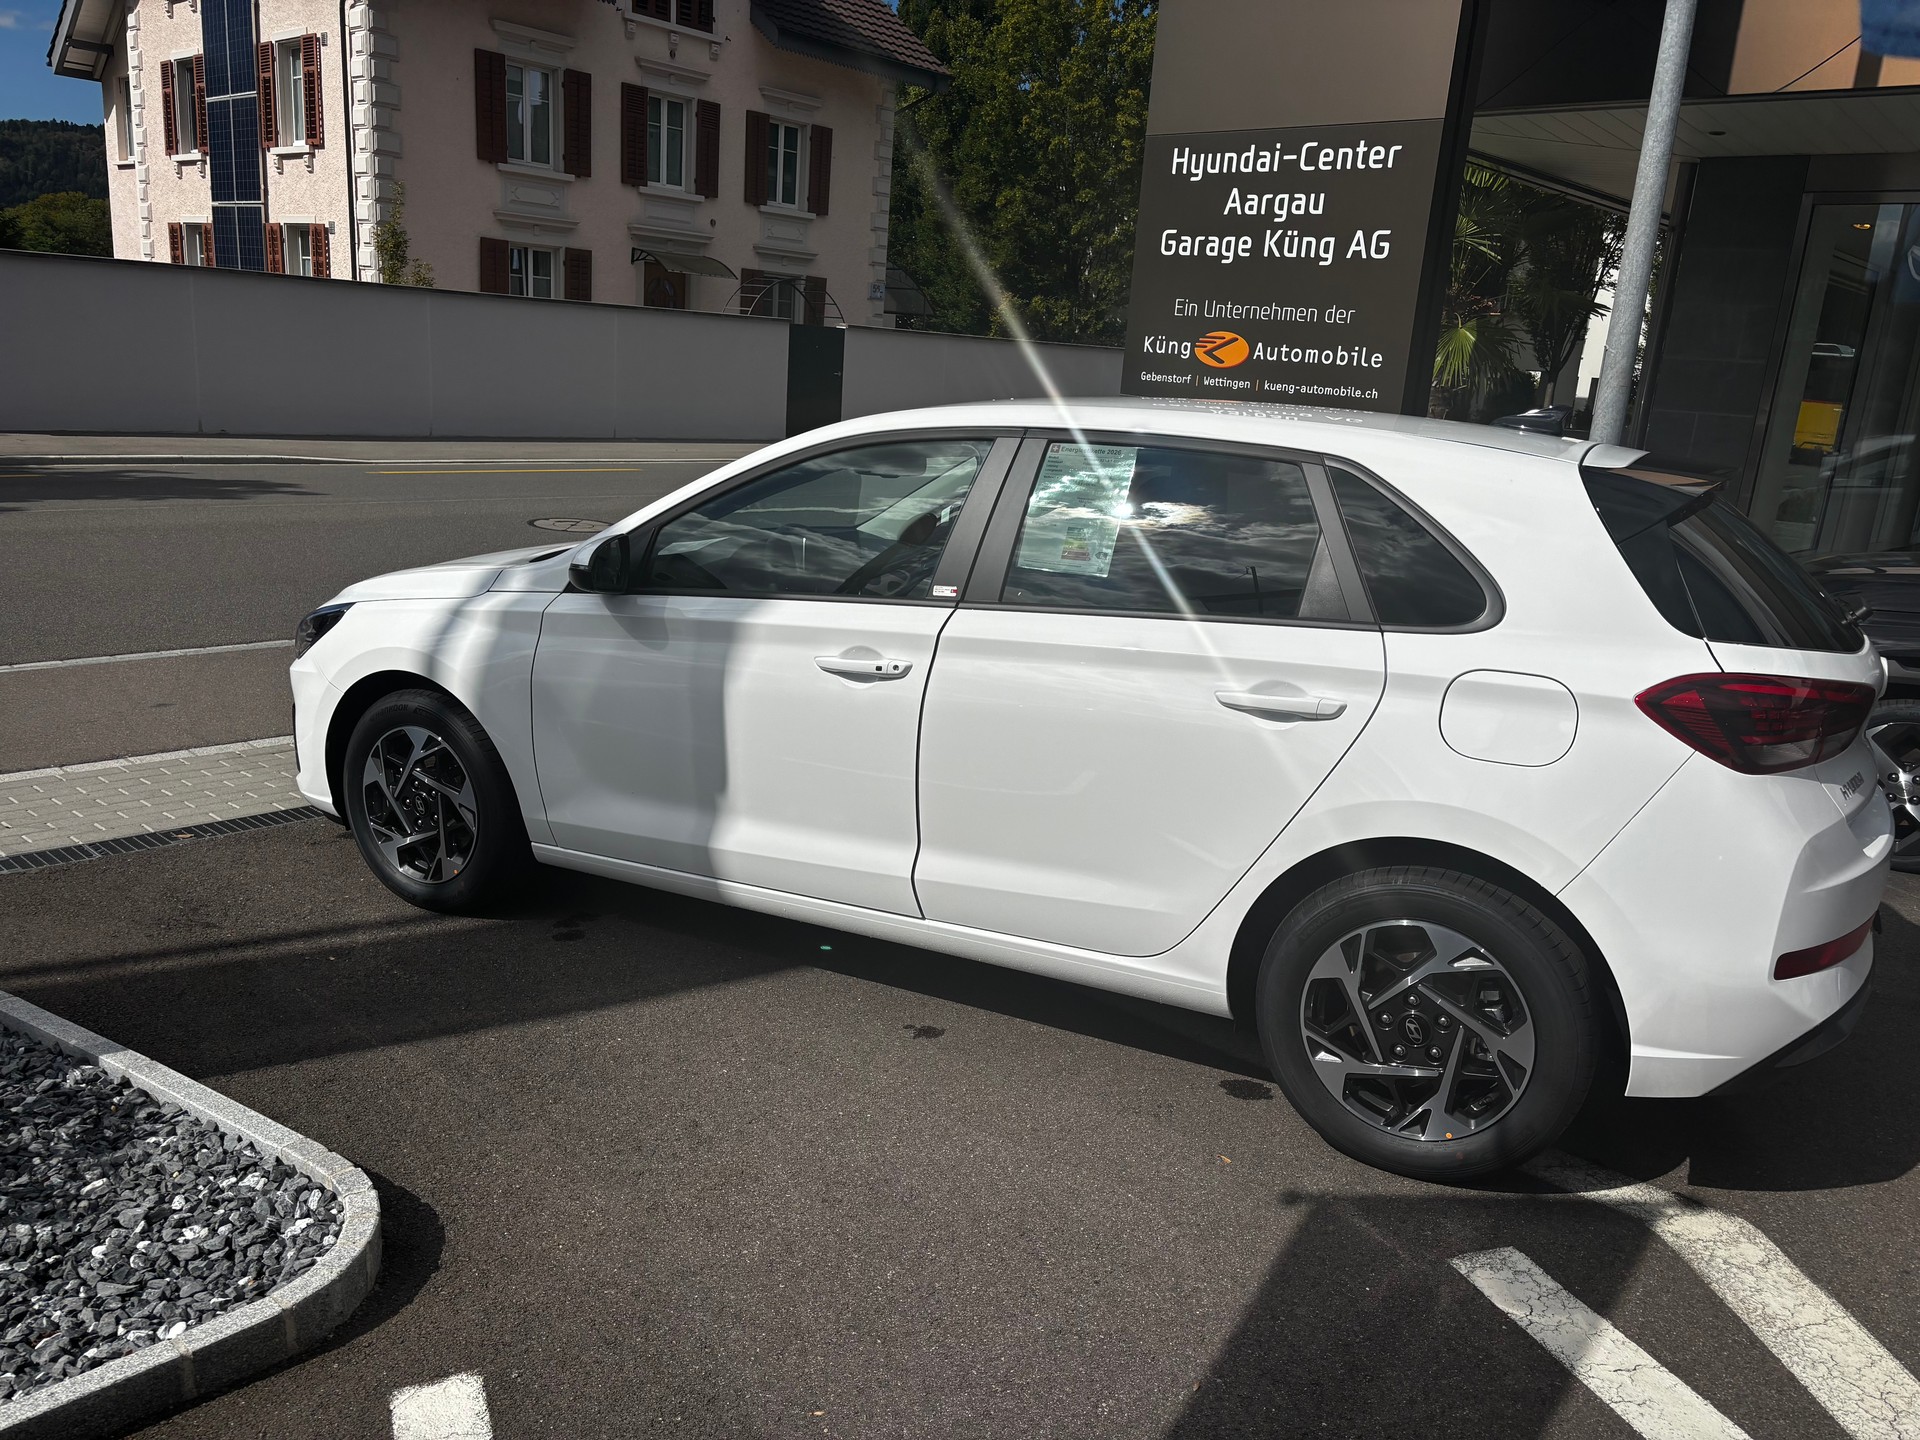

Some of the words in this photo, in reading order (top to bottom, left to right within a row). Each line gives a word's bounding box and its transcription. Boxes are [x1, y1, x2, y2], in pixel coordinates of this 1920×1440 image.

[1172, 140, 1402, 181] Hyundai-Center
[1224, 188, 1325, 222] Aargau
[1161, 230, 1252, 263] Garage
[1264, 230, 1335, 265] Küng
[1346, 230, 1391, 259] AG
[1175, 299, 1197, 316] Ein
[1205, 300, 1317, 322] Unternehmen
[1325, 305, 1355, 323] der
[1144, 336, 1191, 359] Küng
[1253, 342, 1382, 367] Automobile
[1141, 372, 1191, 383] Gebenstorf
[1204, 376, 1250, 389] Wettingen
[1265, 380, 1378, 398] kueng-automobile.ch
[1061, 446, 1105, 455] Energiekette
